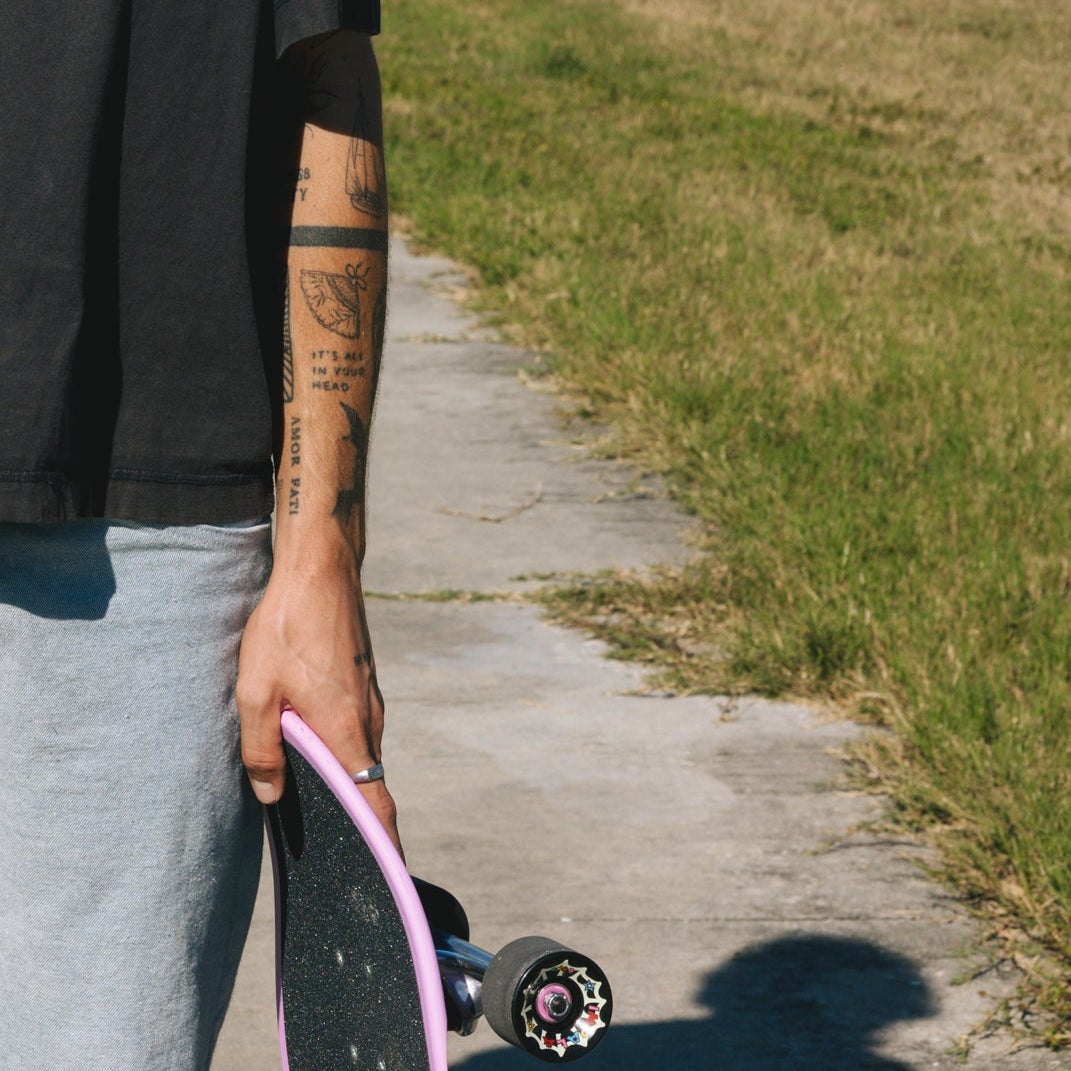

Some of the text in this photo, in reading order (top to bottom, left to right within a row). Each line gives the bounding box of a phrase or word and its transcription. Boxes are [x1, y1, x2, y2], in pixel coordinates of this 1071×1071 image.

[312, 350, 364, 362] IT'S ALL
[312, 366, 366, 378] IN YOUR
[312, 381, 350, 392] HEAD
[291, 416, 302, 467] AMOR
